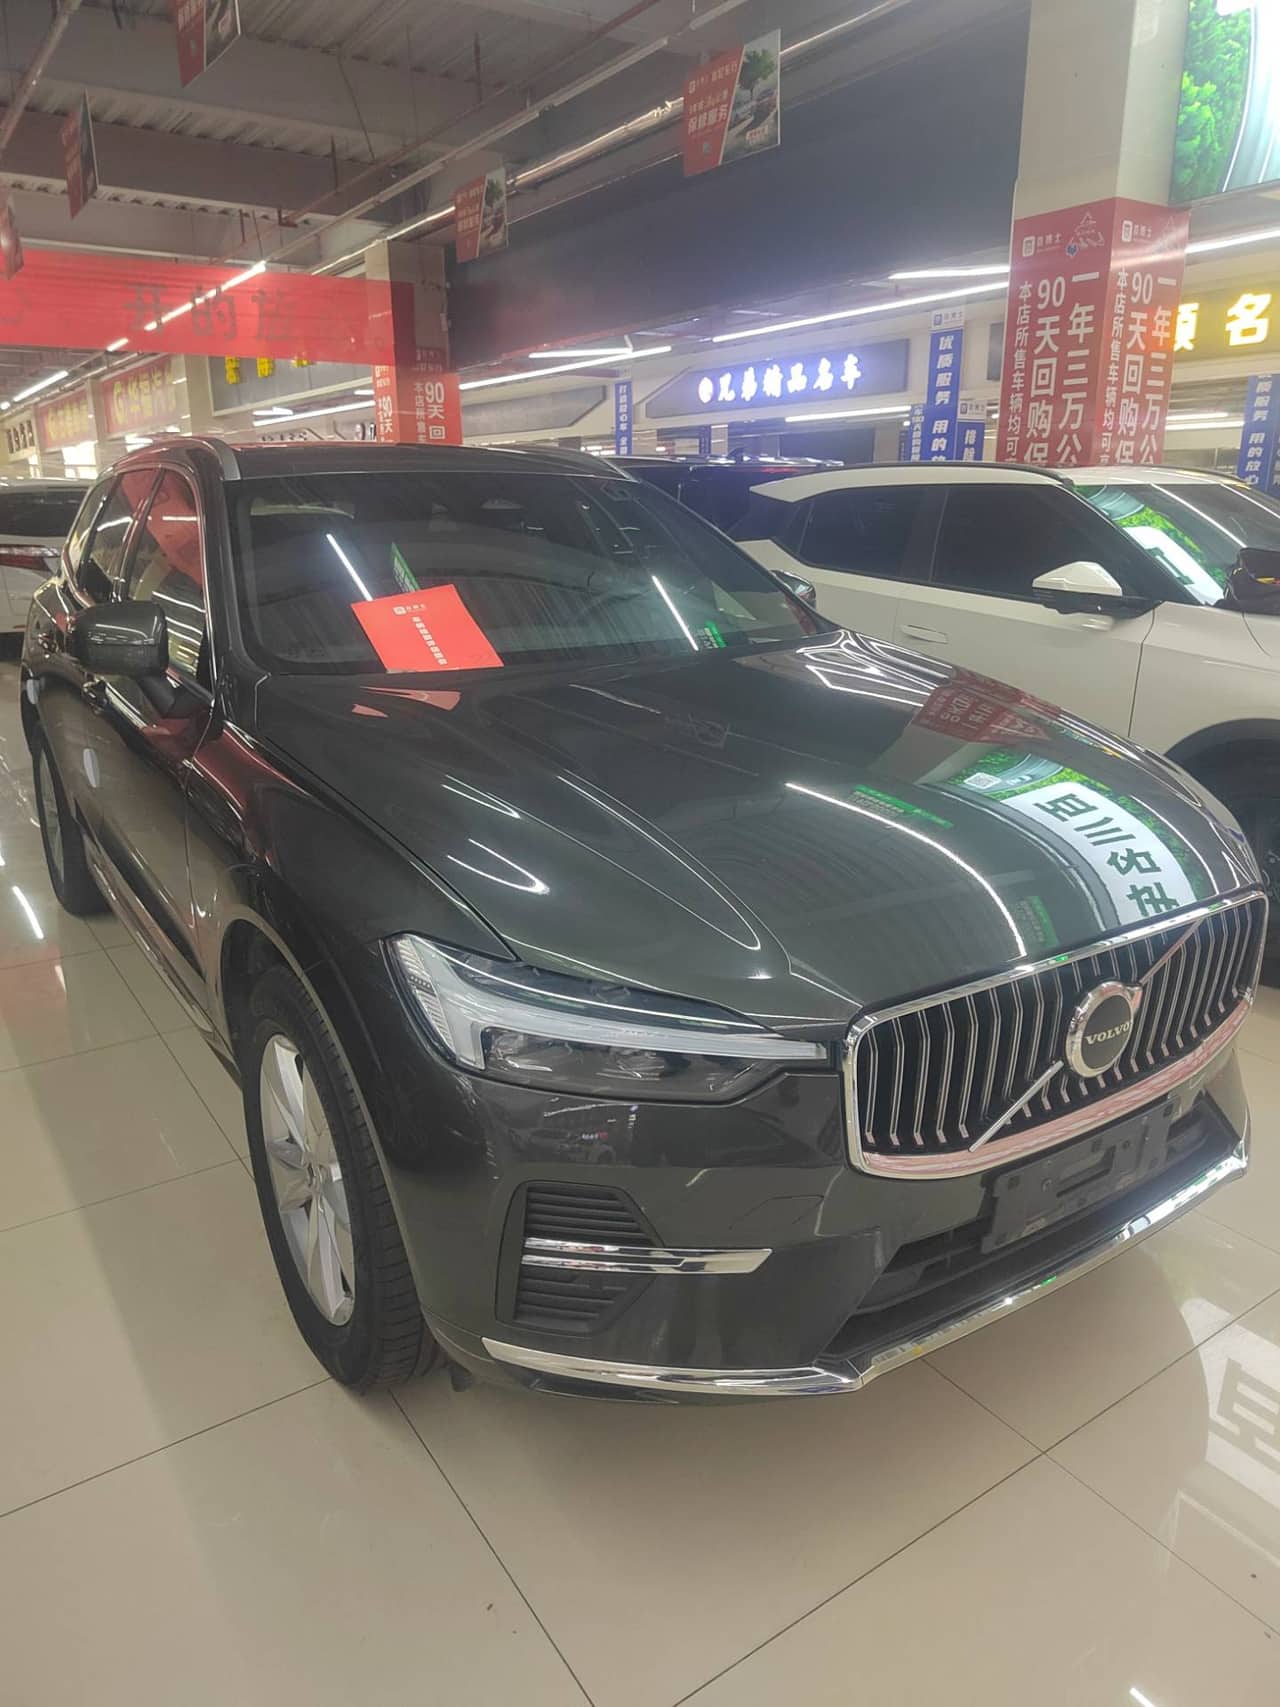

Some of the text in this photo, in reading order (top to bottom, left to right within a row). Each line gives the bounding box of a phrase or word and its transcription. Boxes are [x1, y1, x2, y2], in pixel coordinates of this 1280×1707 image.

[1006, 281, 1032, 464] 本店所售车辆均可
[1085, 1021, 1131, 1045] VOLVO
